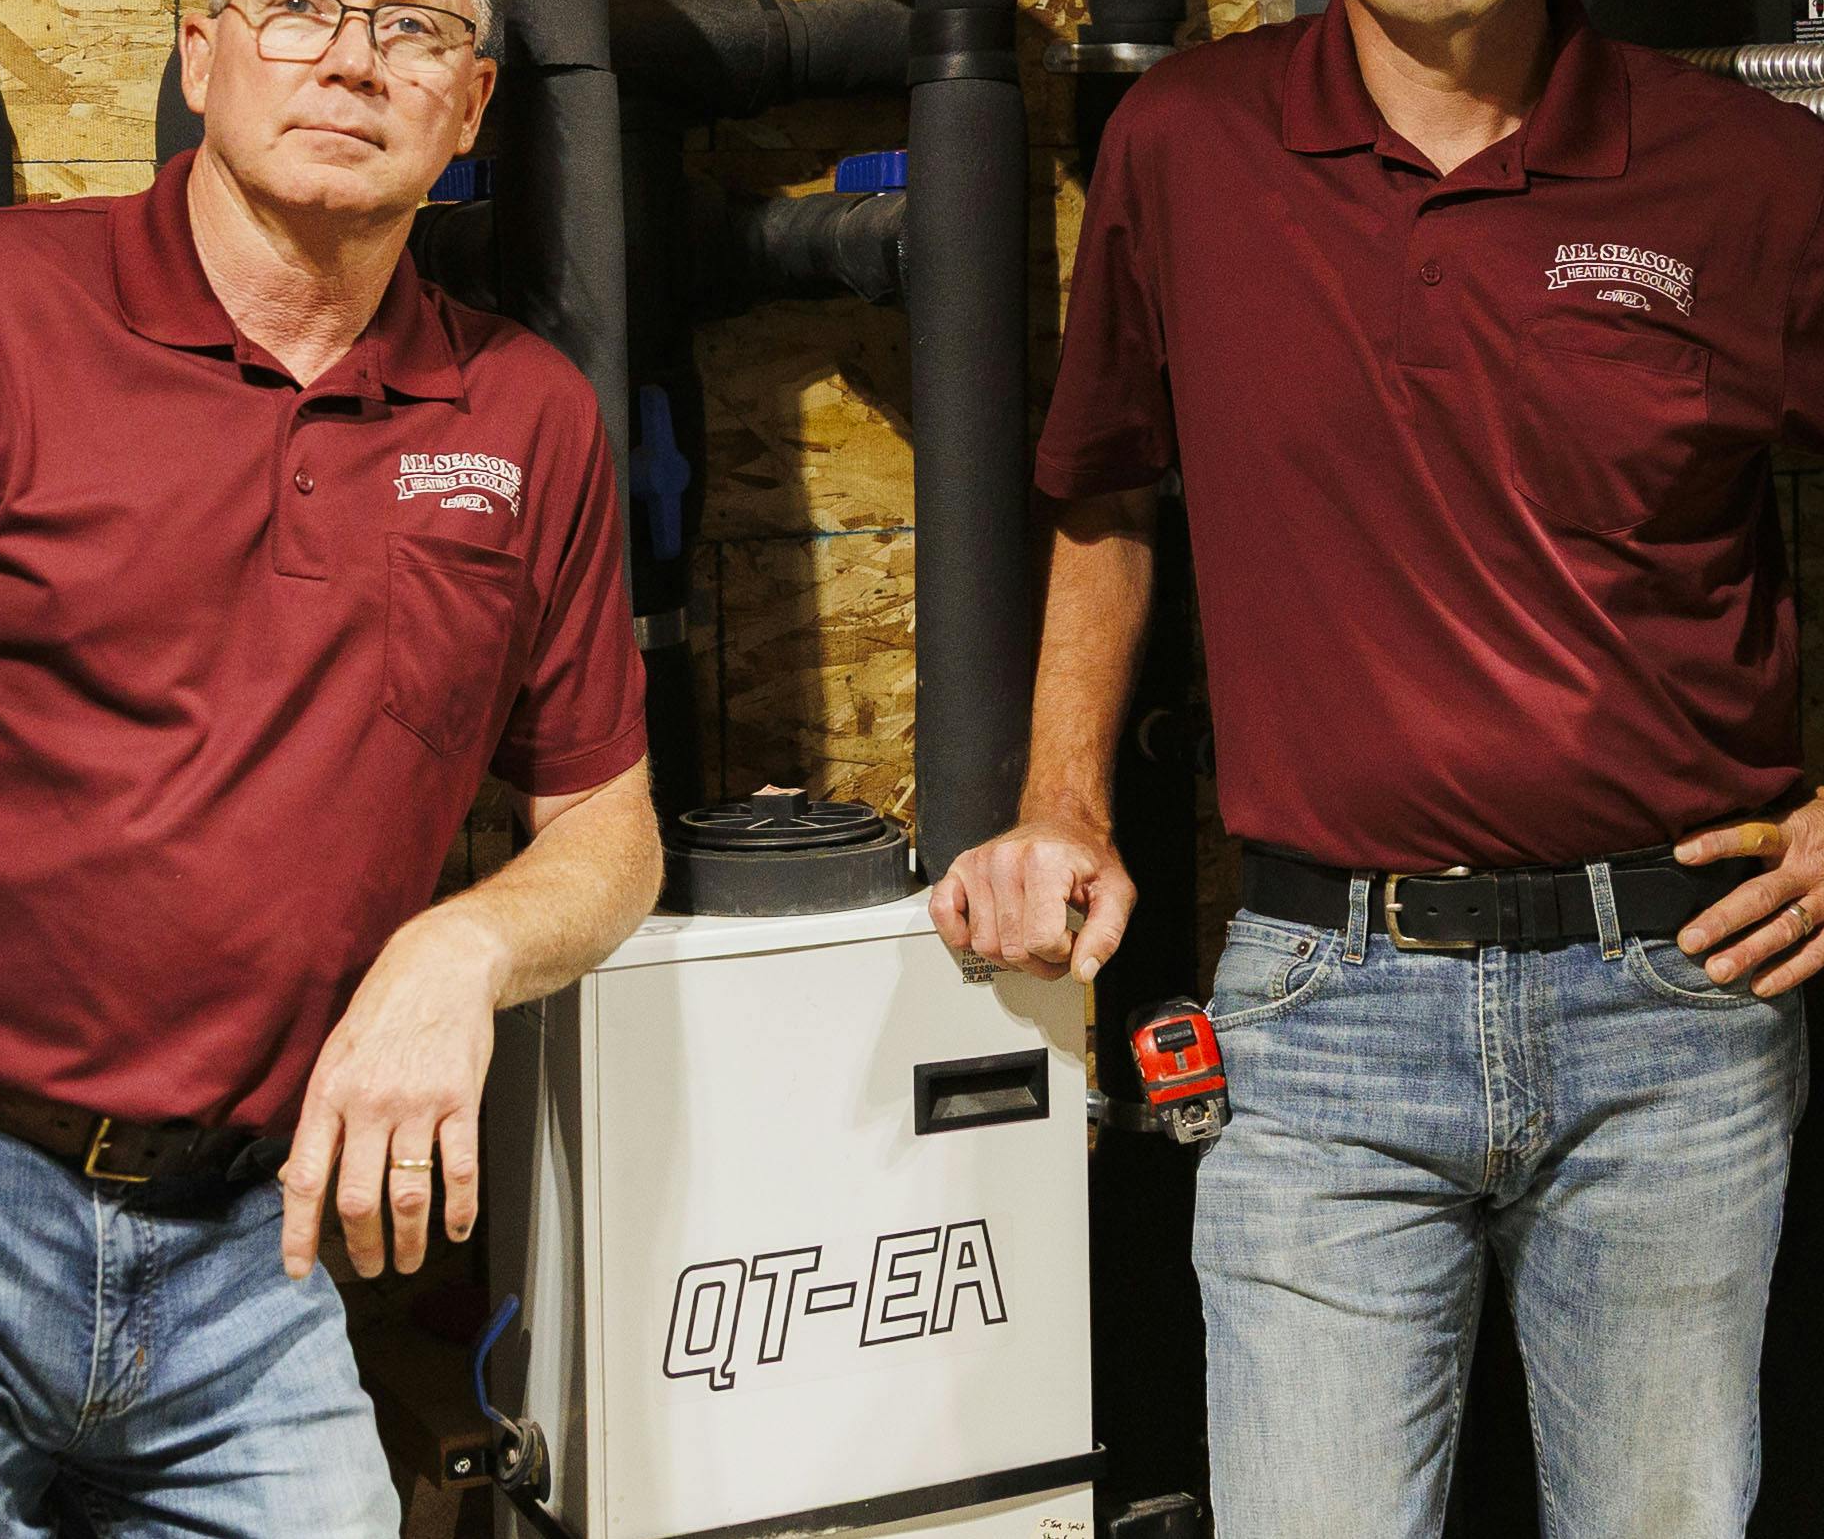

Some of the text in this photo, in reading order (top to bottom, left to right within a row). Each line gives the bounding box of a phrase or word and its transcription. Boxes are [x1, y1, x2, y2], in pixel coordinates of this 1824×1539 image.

[1555, 244, 1694, 285] ALL SEASONS
[1567, 266, 1683, 297] HEATING & COOLING
[1596, 289, 1642, 308] LENNOX
[399, 453, 522, 486] ALL SEASONS
[410, 474, 520, 498] HEATING & COOLING
[440, 494, 486, 511] LENNOX
[962, 957, 986, 966] FLOW
[663, 1218, 1007, 1390] QT-EA
